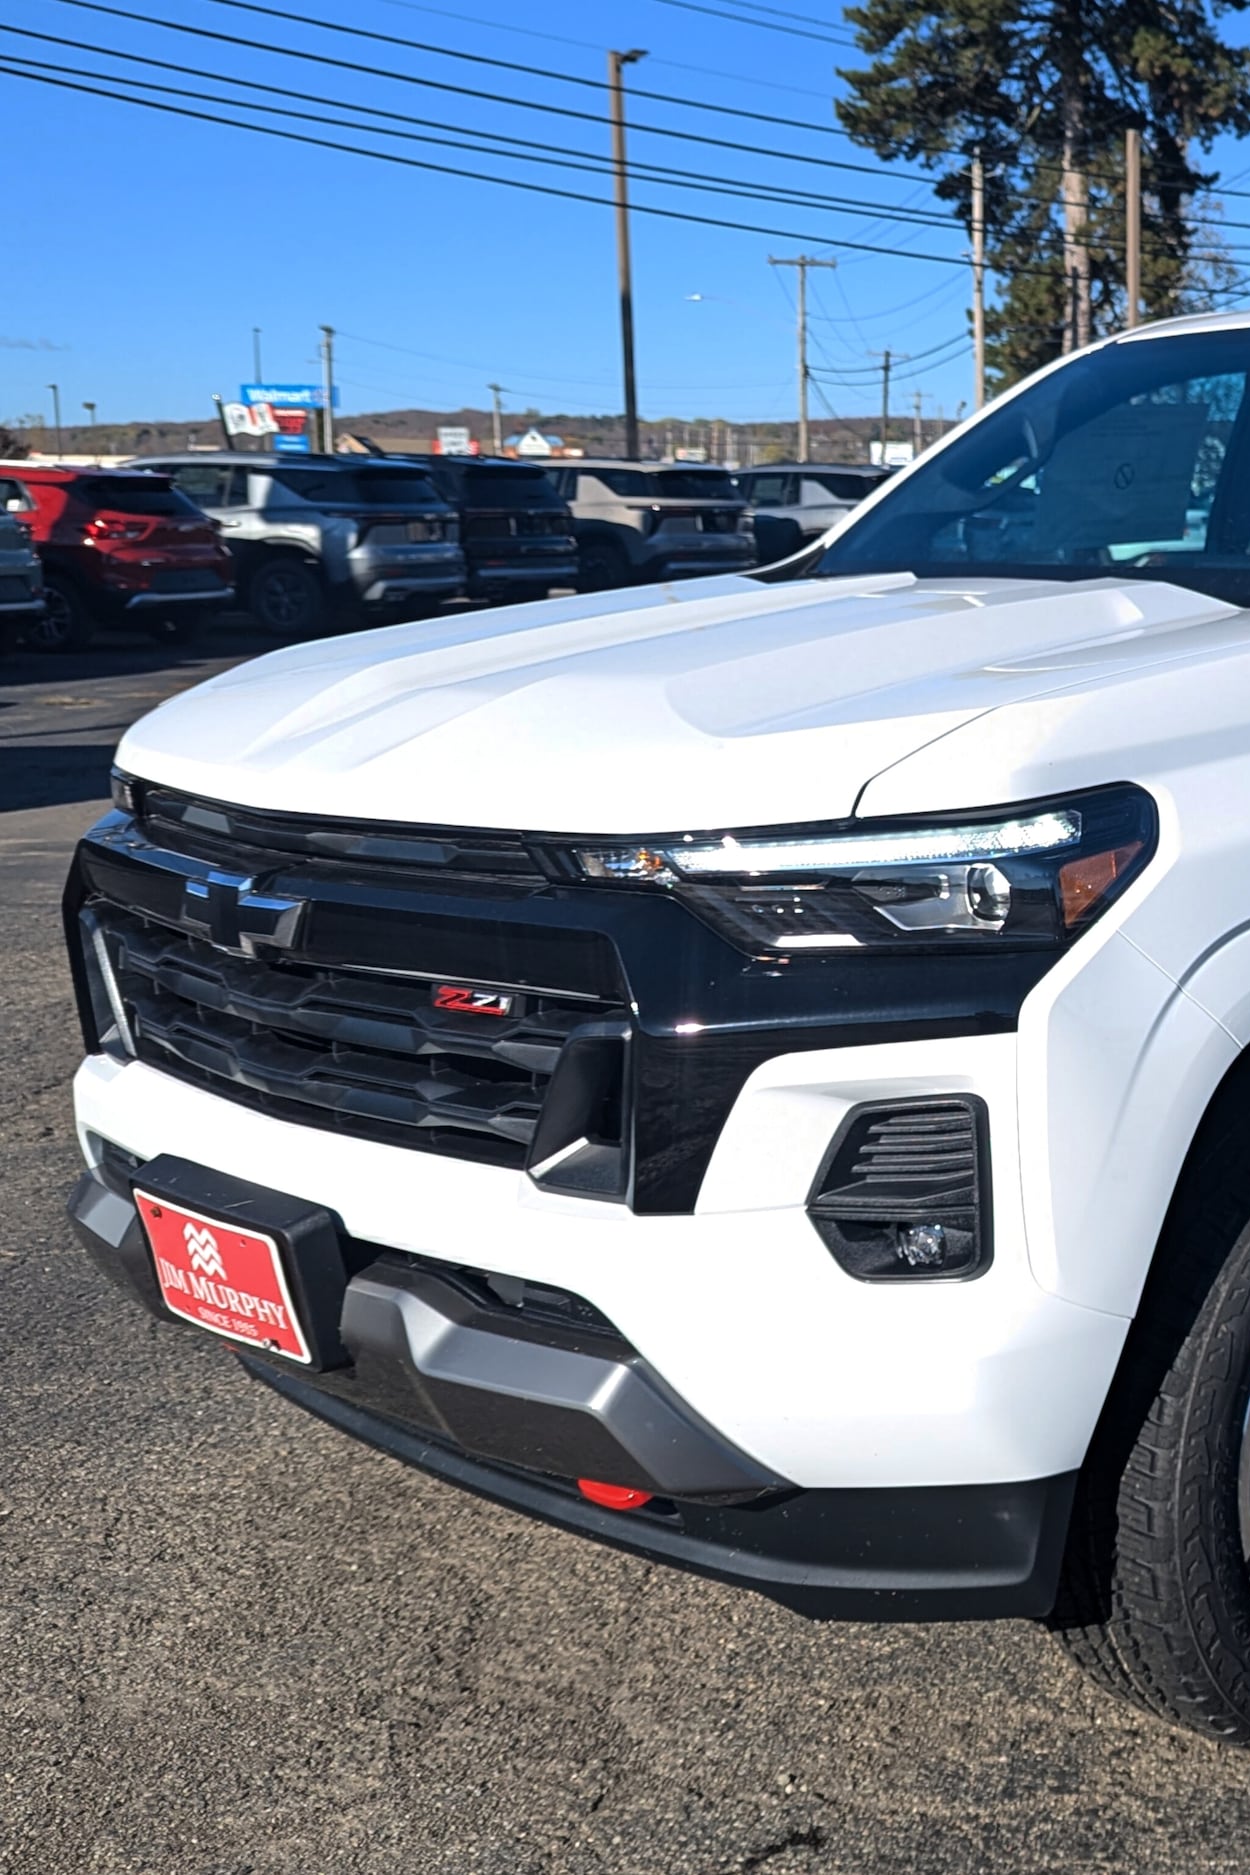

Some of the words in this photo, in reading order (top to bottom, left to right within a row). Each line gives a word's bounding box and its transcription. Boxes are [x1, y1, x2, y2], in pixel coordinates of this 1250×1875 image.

[246, 387, 311, 402] Walmart
[435, 986, 511, 1015] Z71
[158, 1257, 191, 1295] JIM
[187, 1272, 288, 1330] MURPHY
[197, 1306, 233, 1329] SINCE
